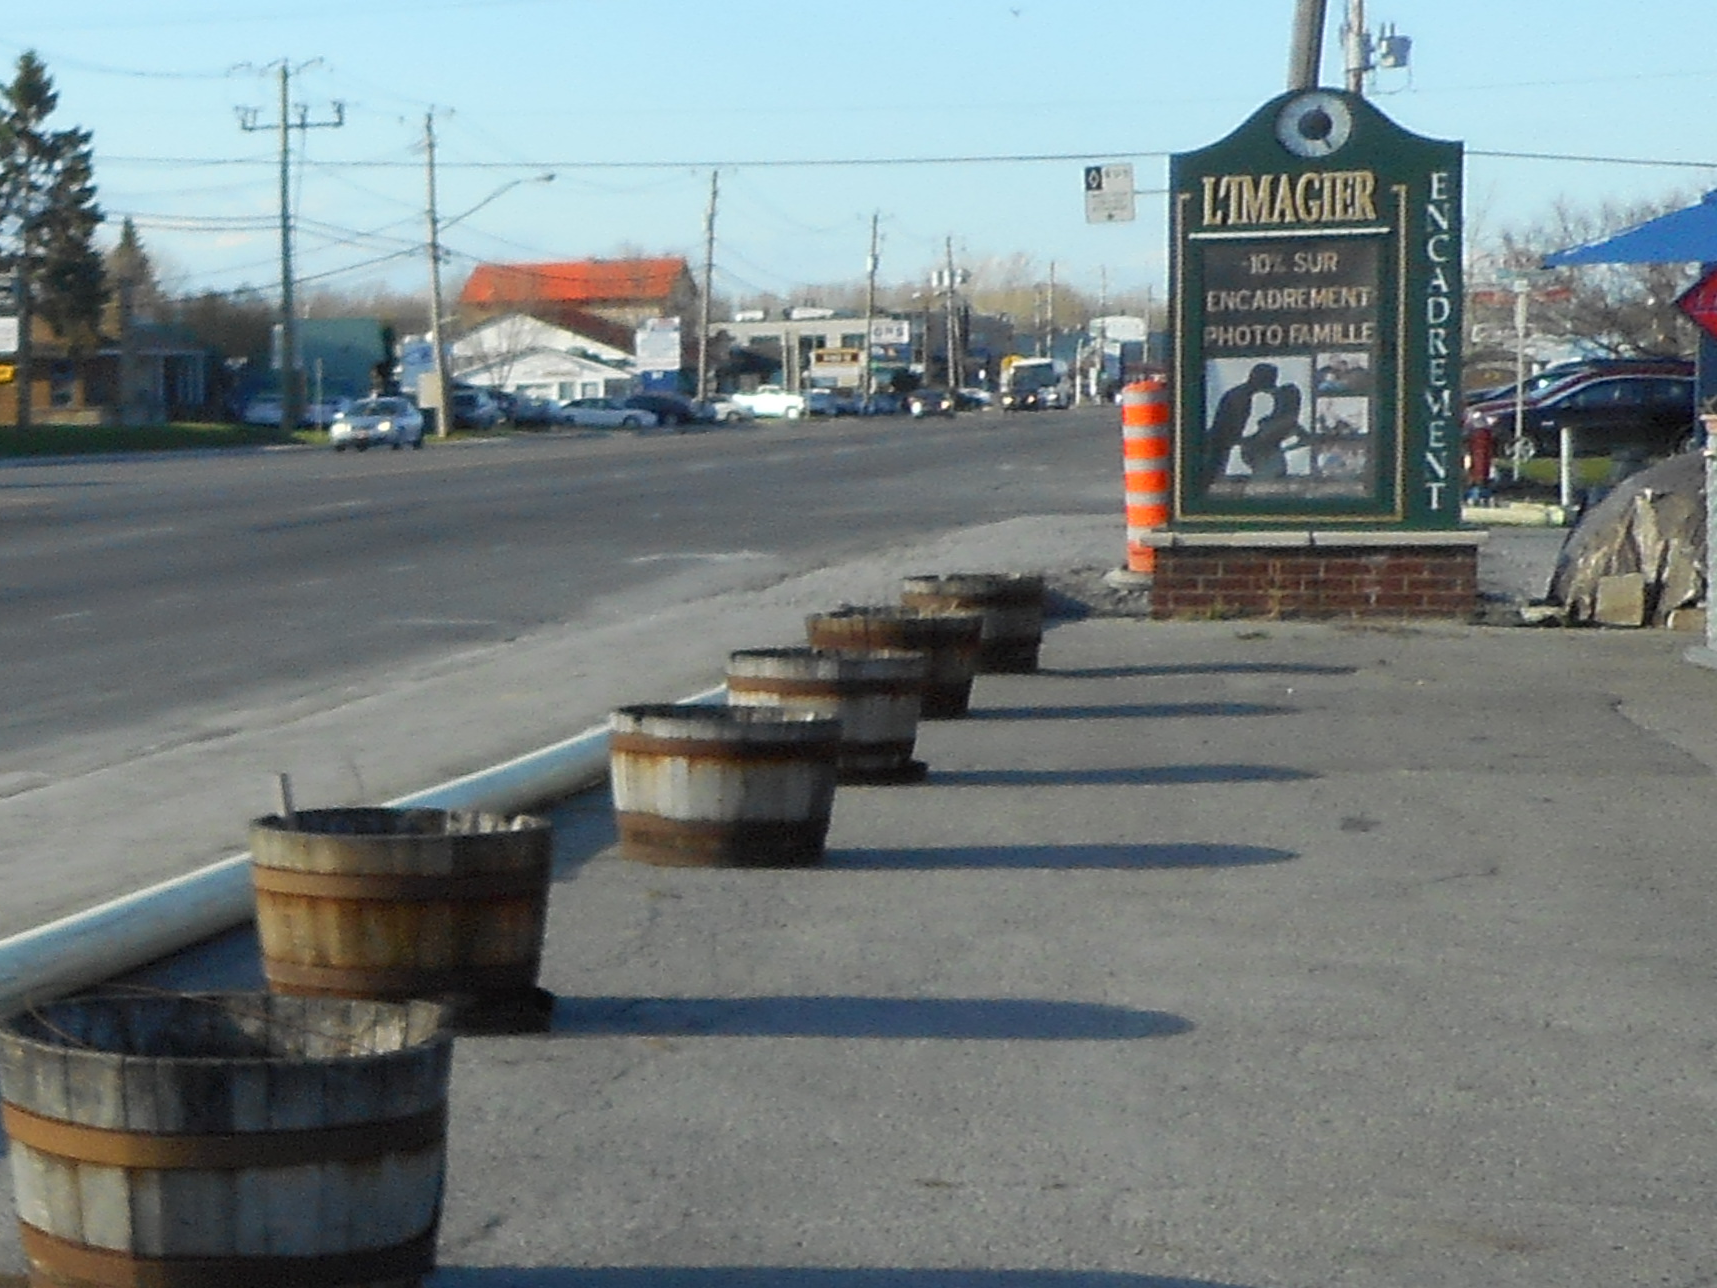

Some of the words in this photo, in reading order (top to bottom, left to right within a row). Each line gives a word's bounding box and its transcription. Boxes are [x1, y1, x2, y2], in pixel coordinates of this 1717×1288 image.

[1202, 170, 1377, 226] L'IMAGIER
[1293, 250, 1339, 273] SUR
[1206, 286, 1371, 313] ENCADREMENT
[1204, 324, 1283, 347] PHOTO
[1289, 321, 1376, 346] FAMILLE
[1423, 172, 1453, 510] ENCADREMENT
